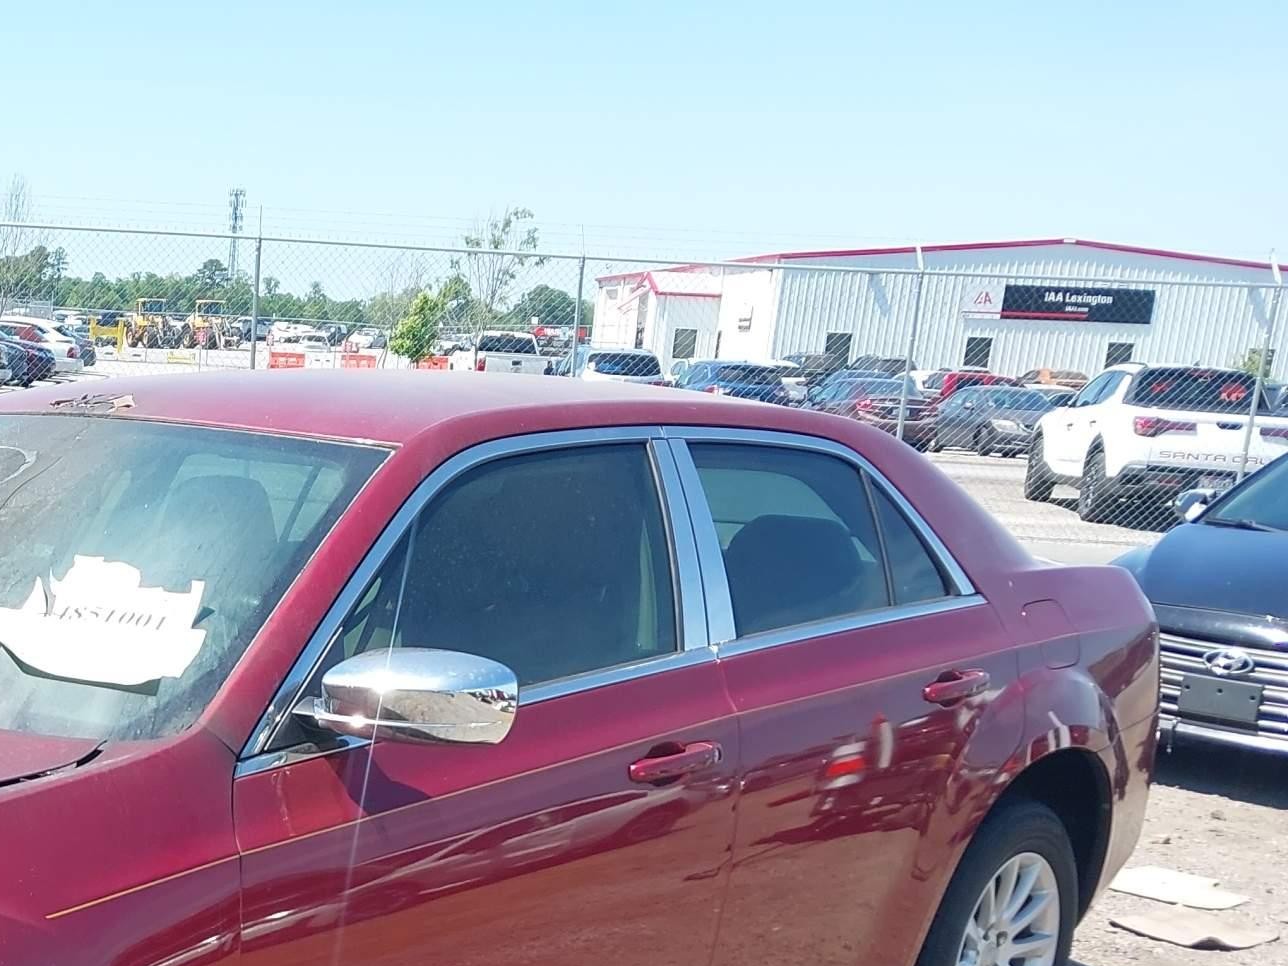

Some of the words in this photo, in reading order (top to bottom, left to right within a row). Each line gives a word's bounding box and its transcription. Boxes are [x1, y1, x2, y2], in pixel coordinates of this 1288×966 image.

[1044, 291, 1063, 303] IAA
[1065, 293, 1113, 306] Lexington
[1159, 450, 1227, 462] SANTA
